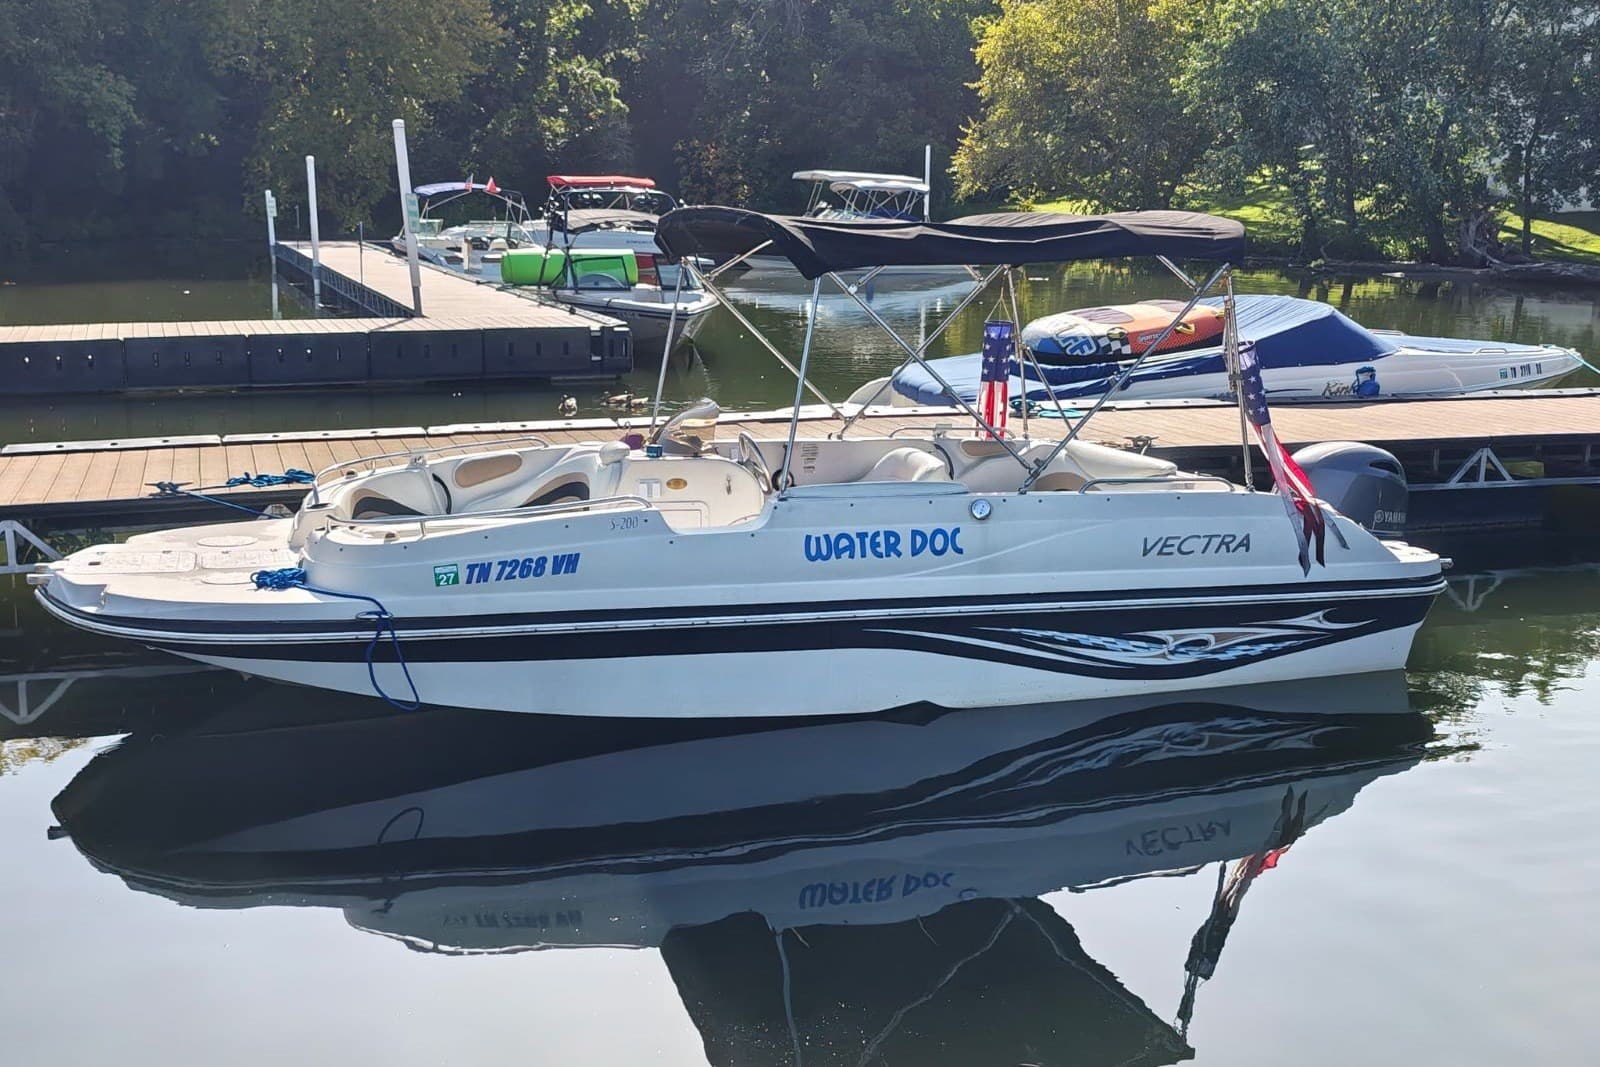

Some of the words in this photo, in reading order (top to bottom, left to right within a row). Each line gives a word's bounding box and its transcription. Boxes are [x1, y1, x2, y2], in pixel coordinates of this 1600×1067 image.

[610, 515, 640, 531] S-200
[804, 530, 902, 562] WATER
[911, 527, 964, 557] DOC
[1141, 532, 1251, 557] VECTRA
[438, 573, 455, 585] 27
[465, 562, 492, 584] TN
[495, 556, 548, 582] 7268
[551, 552, 581, 576] VH
